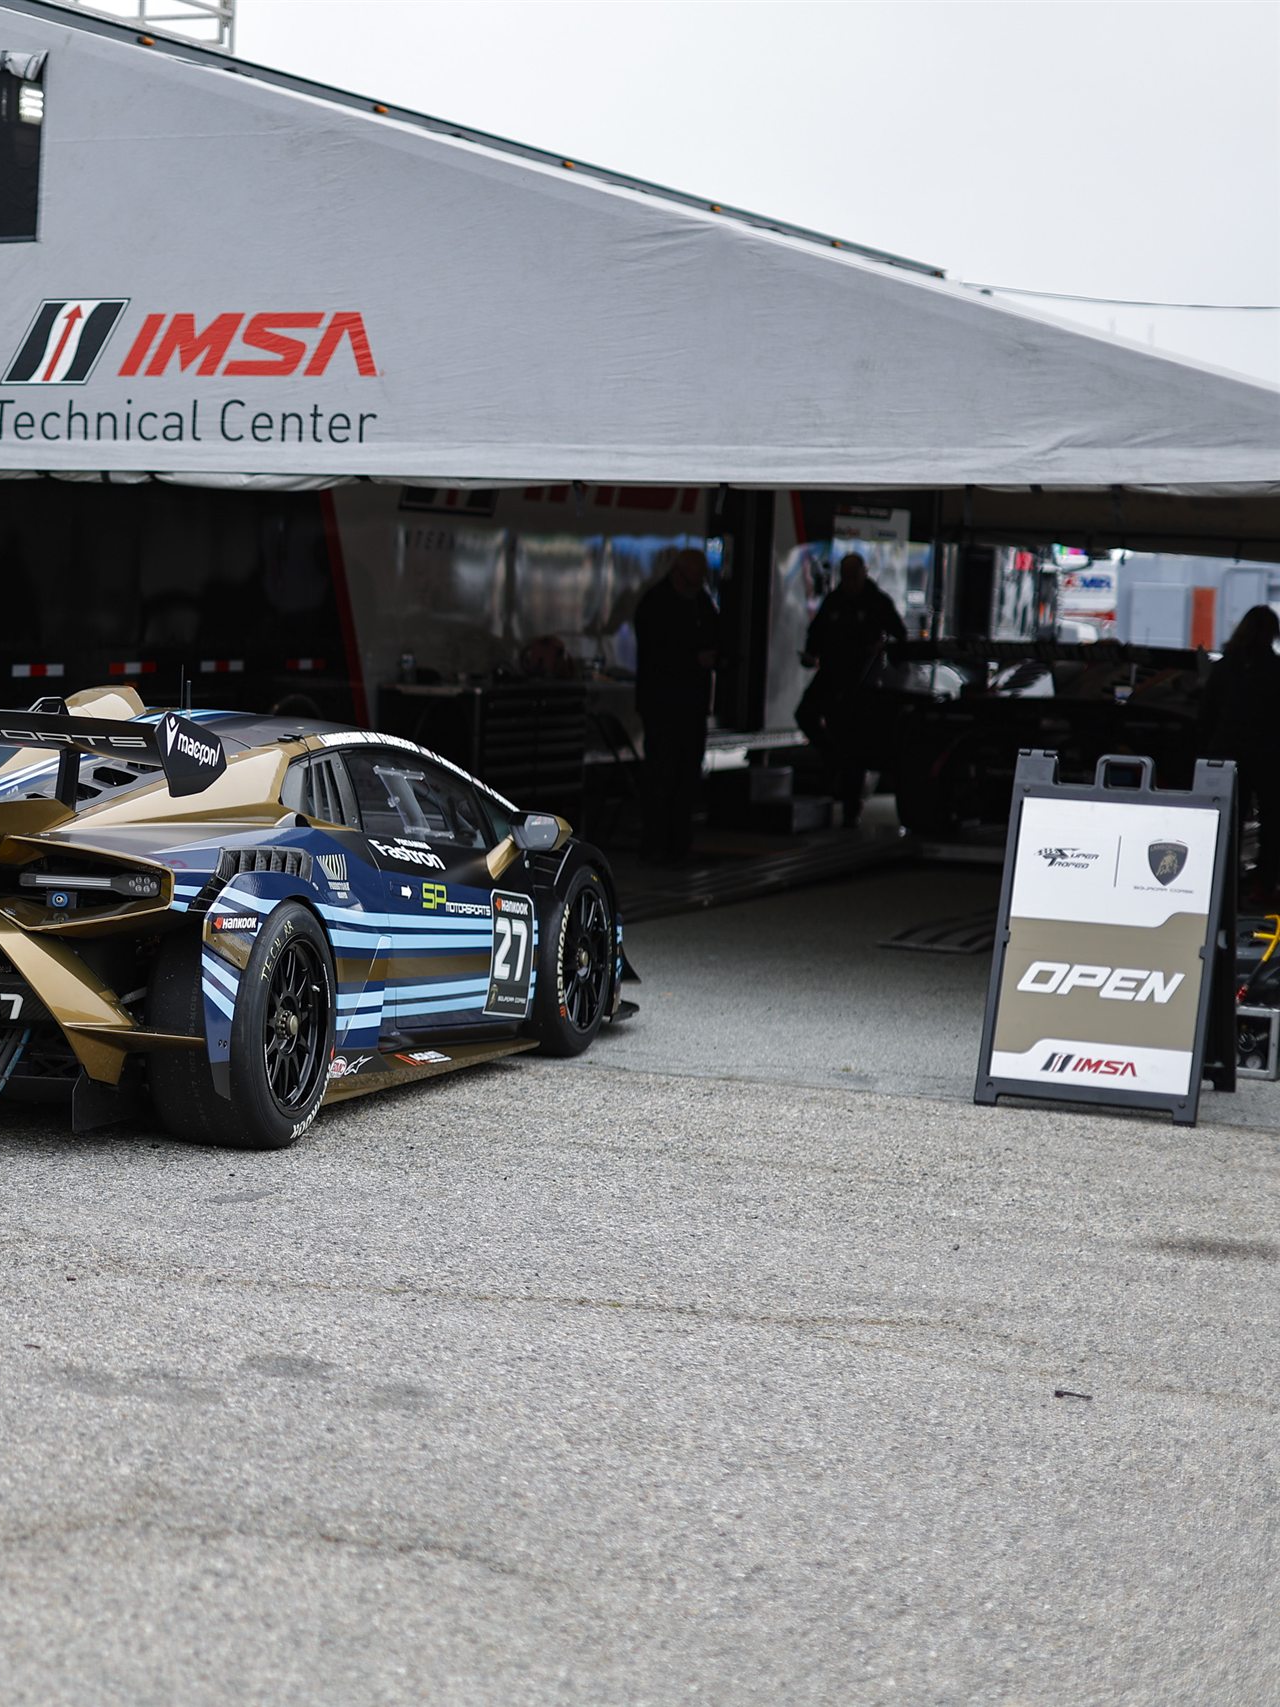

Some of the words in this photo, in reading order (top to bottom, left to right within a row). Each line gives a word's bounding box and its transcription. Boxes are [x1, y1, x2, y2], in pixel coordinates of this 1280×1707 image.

[118, 311, 378, 377] IMSA
[220, 399, 377, 443] Center
[368, 839, 446, 870] Fastron
[422, 882, 447, 910] SP
[446, 902, 491, 916] MOTORSPORTS
[494, 917, 528, 981] 27
[1017, 961, 1185, 1004] OPEN
[1072, 1056, 1138, 1078] IMSA
